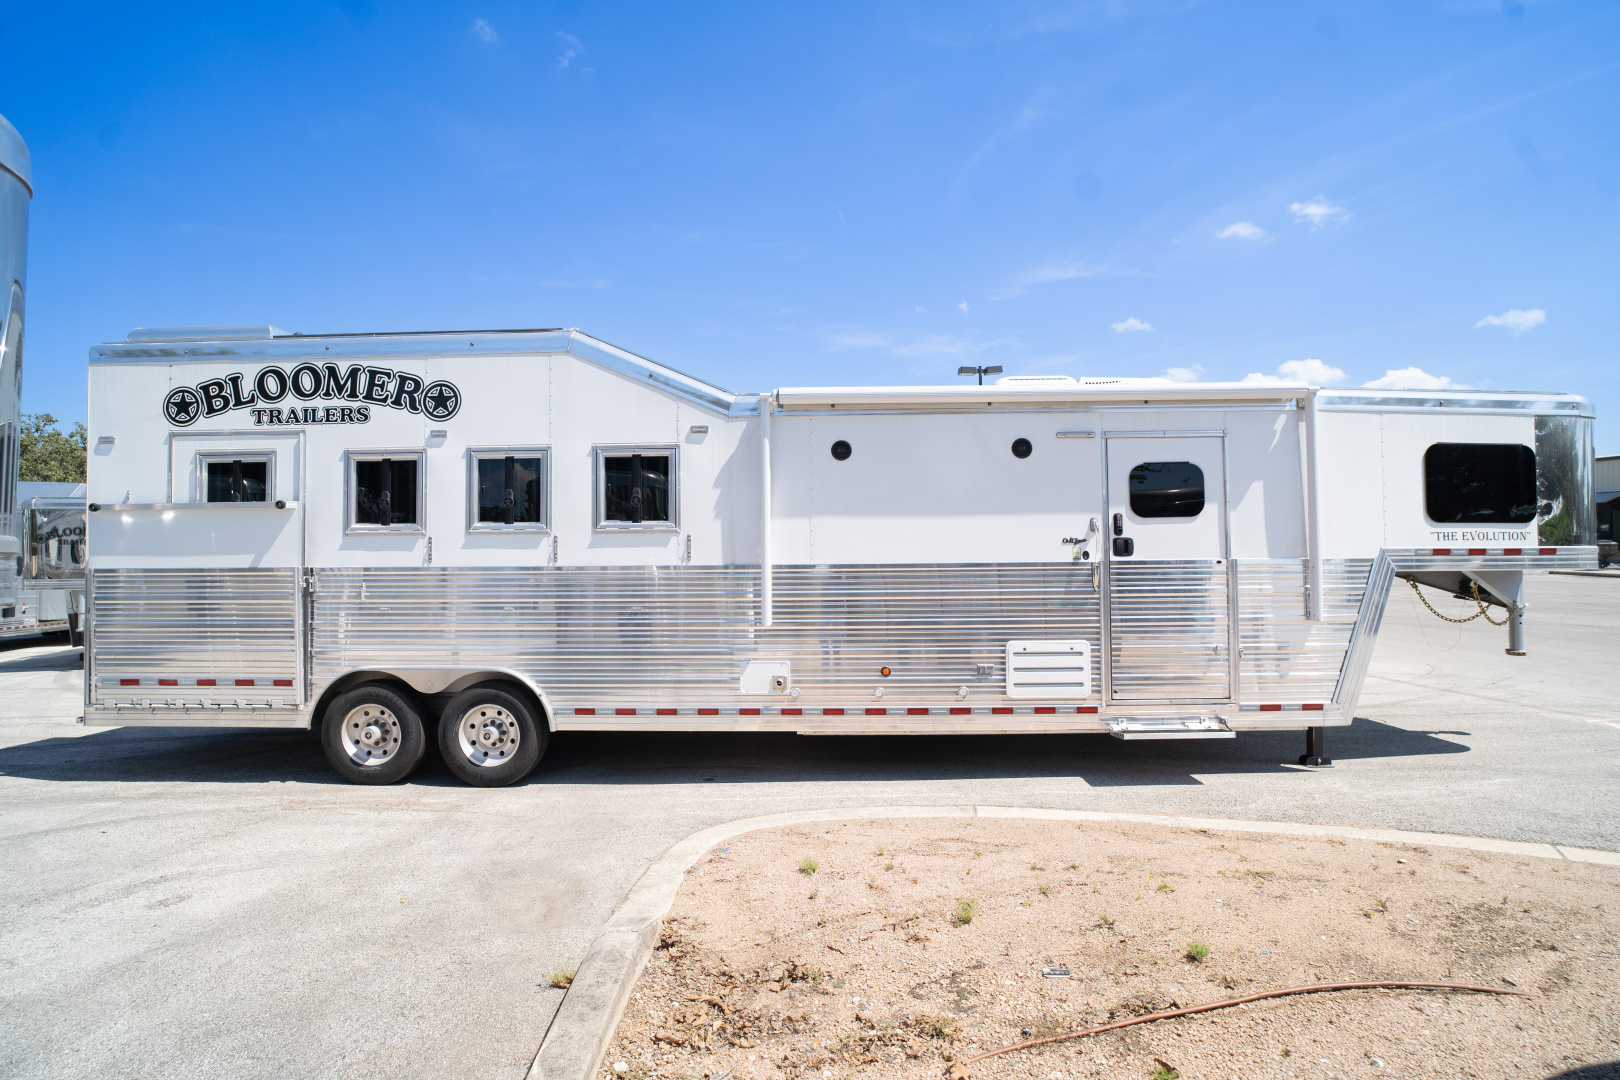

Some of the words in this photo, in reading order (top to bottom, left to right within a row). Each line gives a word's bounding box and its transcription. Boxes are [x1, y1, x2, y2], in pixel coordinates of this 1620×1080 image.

[196, 362, 424, 419] BLOOMER
[250, 405, 371, 426] TRAILERS
[45, 525, 87, 540] BLOO
[1431, 531, 1458, 541] "THE
[1462, 530, 1531, 541] EVOLUTION"
